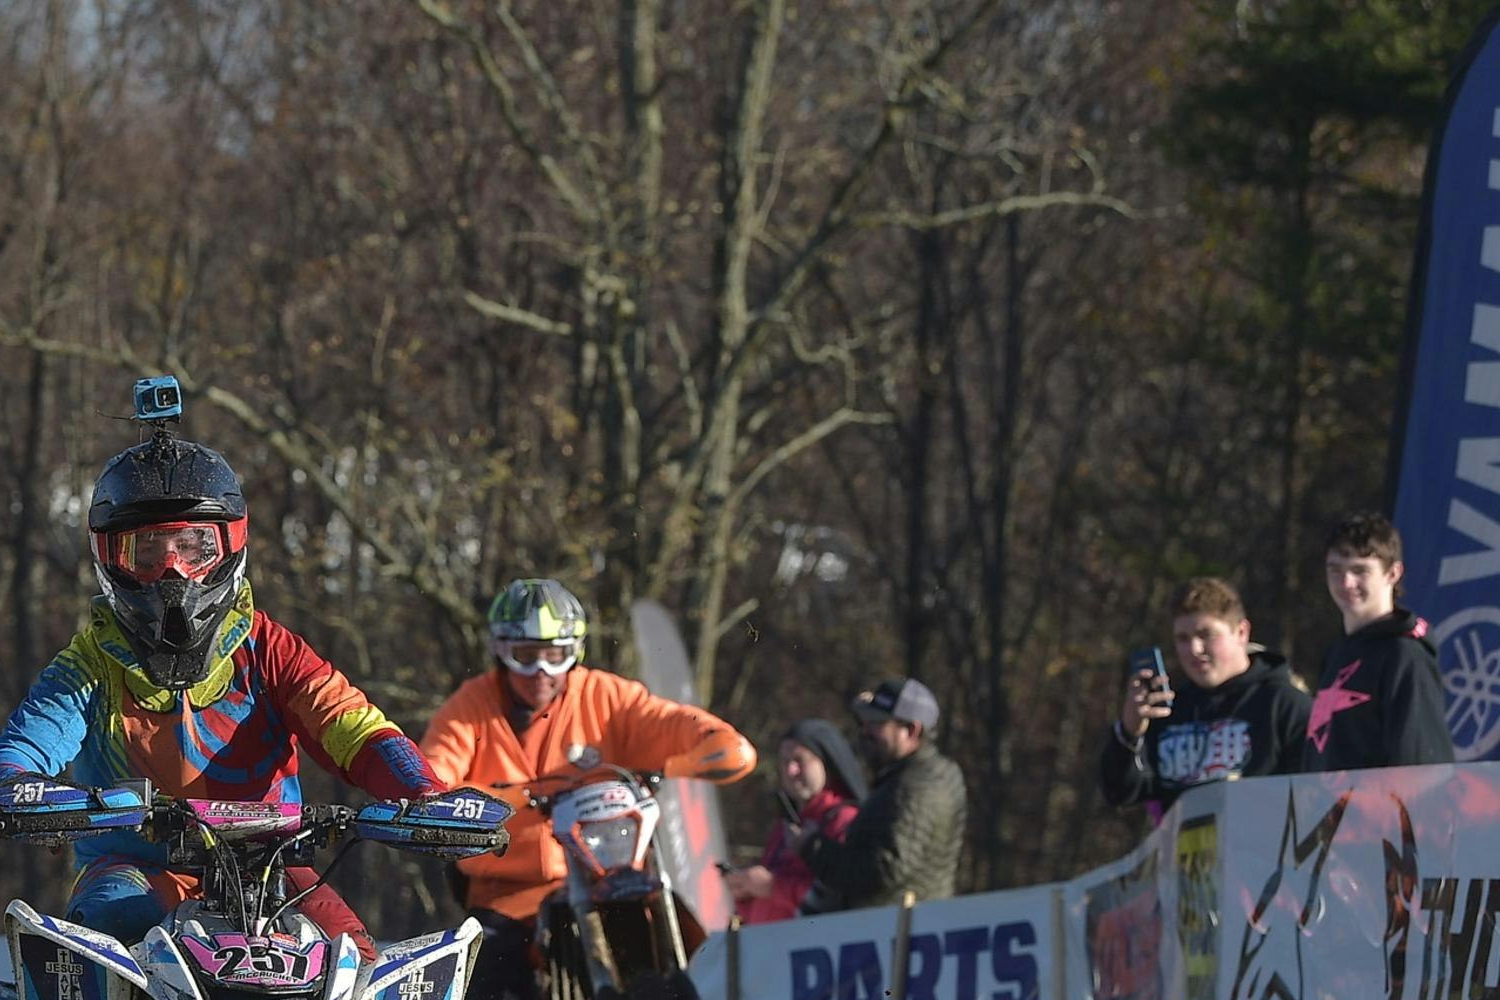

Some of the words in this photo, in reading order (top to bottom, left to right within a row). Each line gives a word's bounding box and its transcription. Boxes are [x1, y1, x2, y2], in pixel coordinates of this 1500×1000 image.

[12, 782, 45, 804] 257
[452, 797, 485, 819] 257
[46, 963, 83, 974] JESUS
[212, 944, 309, 980] 257
[400, 982, 432, 993] JESUS
